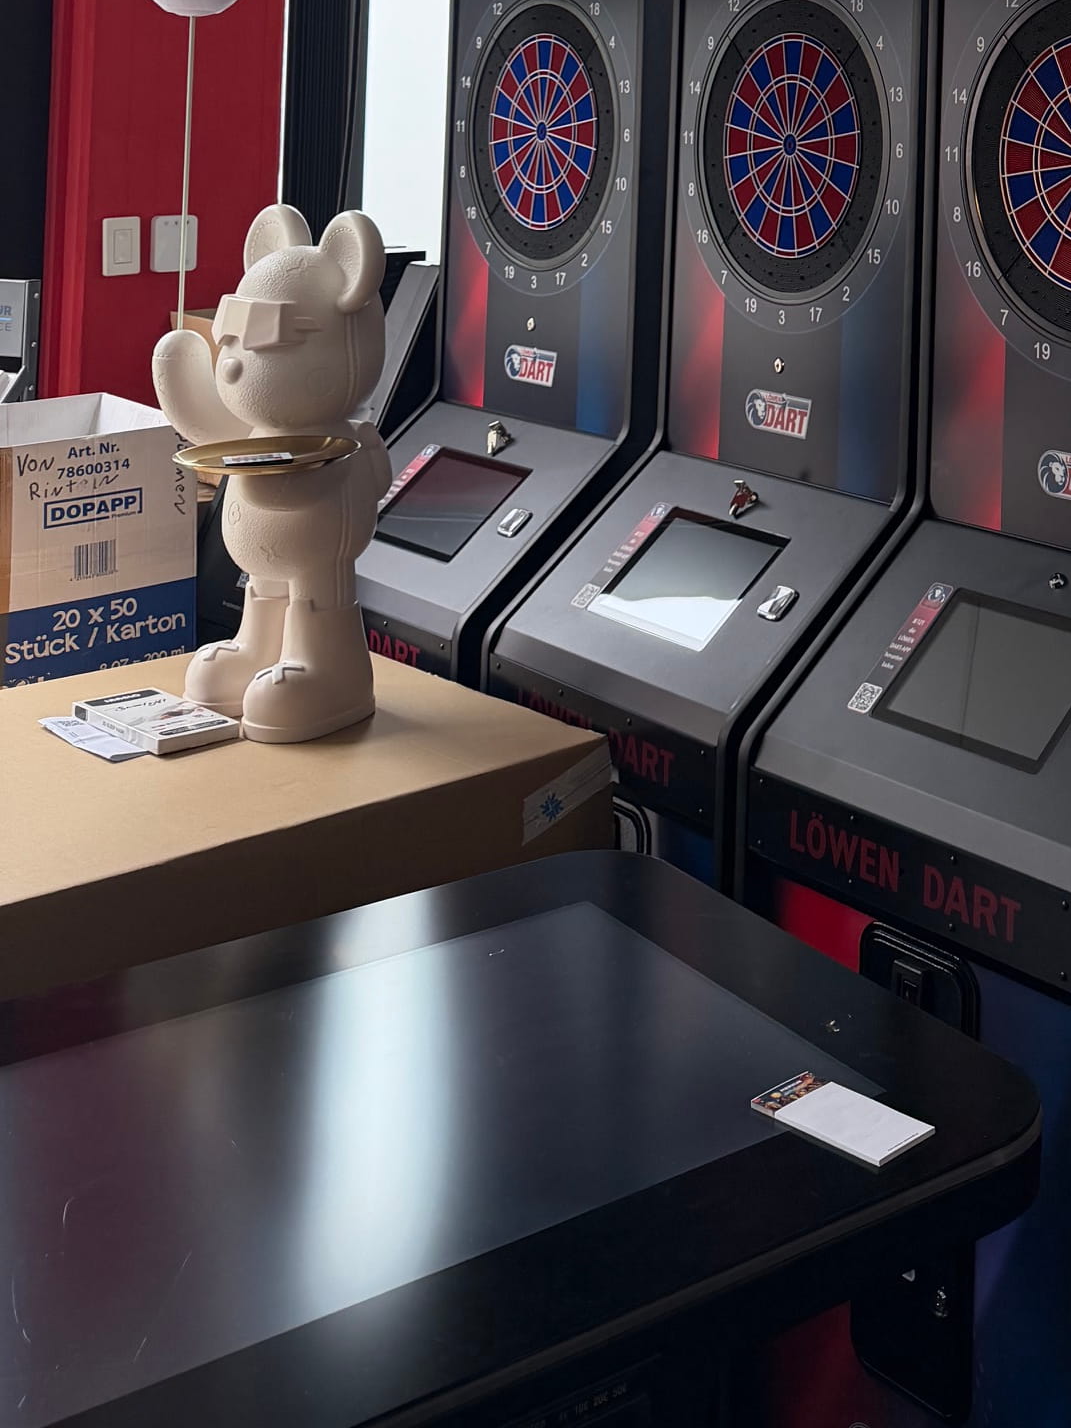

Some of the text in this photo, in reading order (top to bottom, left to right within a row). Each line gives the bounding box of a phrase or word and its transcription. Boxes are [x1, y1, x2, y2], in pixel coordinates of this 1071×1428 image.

[492, 2, 503, 16] 12
[589, 2, 600, 16] 18
[707, 36, 714, 51] 9
[875, 35, 884, 51] 4
[976, 36, 985, 53] 9
[461, 75, 471, 89] 14
[619, 79, 631, 94] 13
[689, 80, 701, 95] 14
[889, 86, 903, 102] 13
[952, 88, 968, 105] 14
[455, 120, 465, 133] 11
[683, 130, 694, 145] 11
[895, 142, 904, 159] 6
[945, 145, 959, 163] 11
[615, 177, 627, 192] 10
[688, 182, 695, 197] 8
[466, 206, 477, 220] 16
[885, 198, 900, 215] 10
[953, 206, 961, 223] 8
[600, 220, 612, 234] 15
[696, 229, 709, 244] 16
[866, 248, 881, 265] 15
[504, 265, 515, 279] 19
[721, 269, 728, 285] 7
[965, 260, 981, 278] 16
[555, 272, 567, 286] 17
[842, 285, 850, 302] 2
[744, 297, 757, 313] 19
[778, 309, 786, 325] 3
[809, 306, 823, 323] 17
[1000, 308, 1009, 326] 7
[1033, 341, 1051, 360] 19
[518, 357, 554, 383] DART
[763, 403, 808, 434] DART
[67, 441, 120, 459] Art. Nr.
[57, 458, 130, 480] 78600314
[50, 495, 137, 522] DOPAPP
[52, 597, 138, 632] 20 x 50
[4, 612, 186, 664] Stück / Karton
[367, 628, 421, 667] DART
[607, 727, 676, 789] DART
[789, 809, 1022, 943] LÖWEN DART
